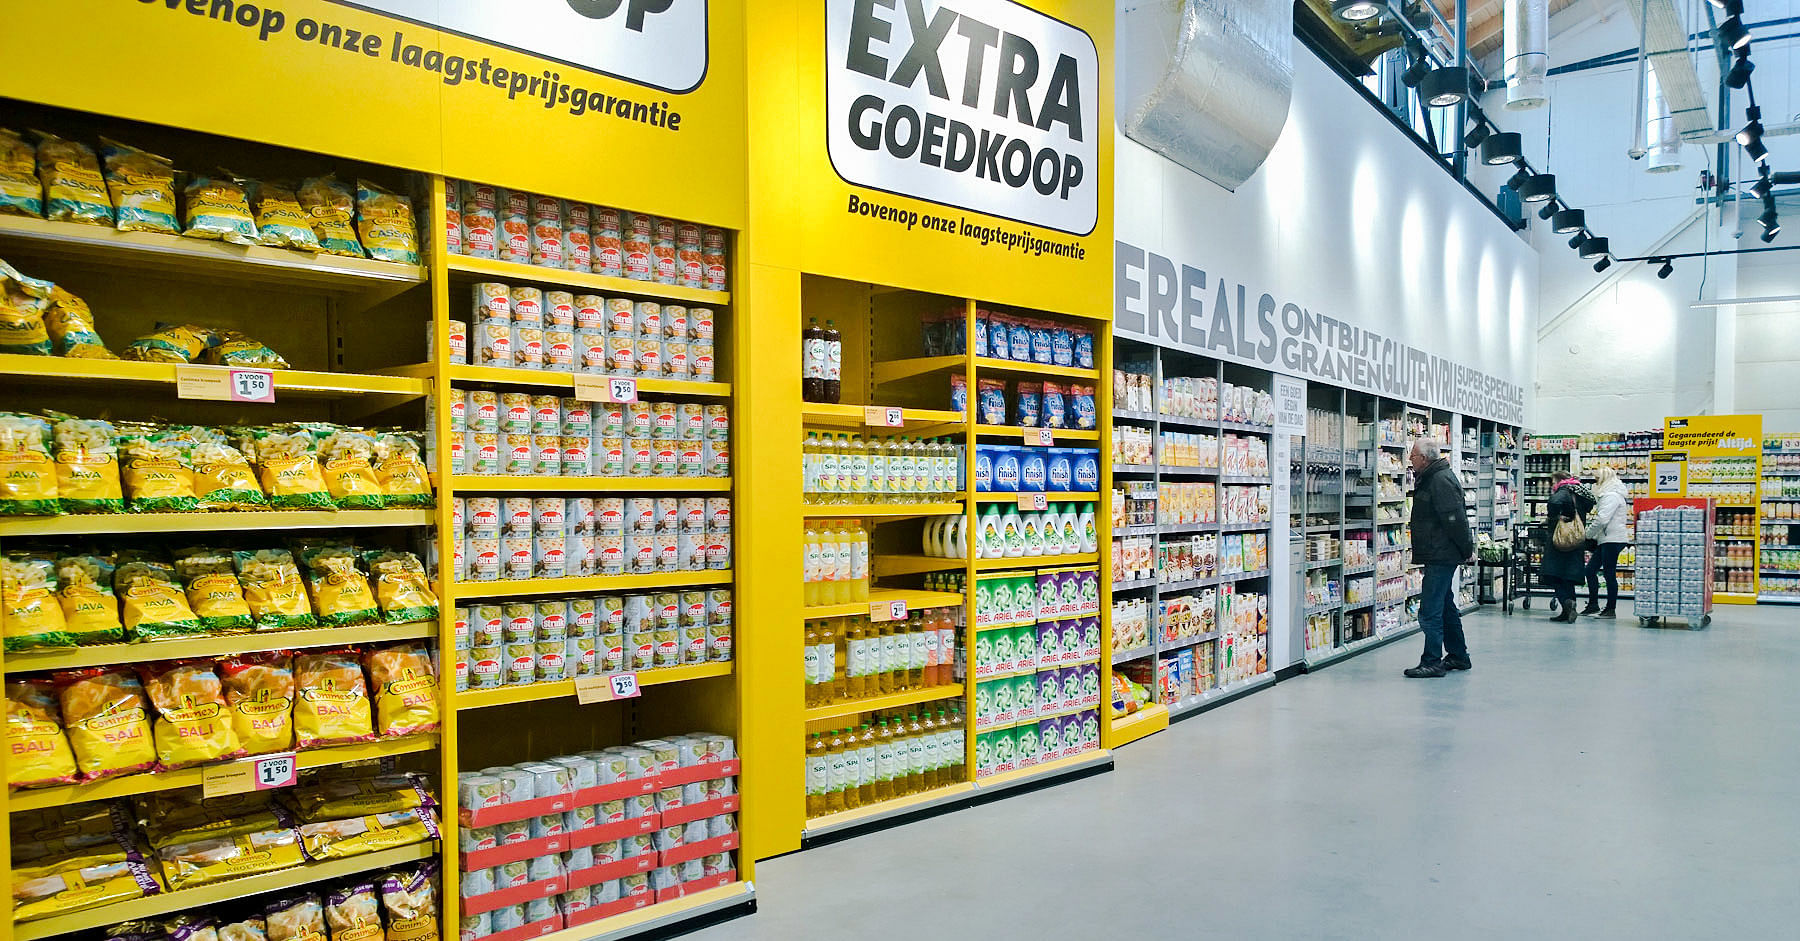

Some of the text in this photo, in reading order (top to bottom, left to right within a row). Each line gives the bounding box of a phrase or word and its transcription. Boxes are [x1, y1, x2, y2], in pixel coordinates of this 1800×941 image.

[137, 0, 682, 132] enop onze laagsteprijsgarantie
[846, 0, 1083, 143] EXTRA
[848, 94, 1084, 201] GOEDKOOP
[848, 194, 1085, 260] Bovenop onze laagsteprijsgarantie
[1115, 239, 1277, 365] EREALS
[1281, 302, 1381, 361] ONTBIJT
[1281, 336, 1381, 391] GRANEN
[1382, 338, 1457, 409] GLUTENVRIJ
[1457, 365, 1484, 392] SUPER
[1484, 374, 1524, 407] SPECIALE
[1456, 388, 1484, 415] FOODS
[1484, 396, 1523, 425] VOEDING
[1668, 431, 1724, 440] Gegarandeerd
[1668, 438, 1718, 447] laagste prijs!
[1717, 437, 1757, 451] Altijd.
[70, 470, 102, 480] JAVA
[277, 469, 306, 479] JAVA
[337, 472, 361, 482] JAVA
[976, 469, 990, 478] nish
[75, 602, 105, 612] JAVA
[144, 598, 175, 608] JAVA
[1060, 603, 1079, 613] ARIEL
[1080, 601, 1098, 610] ARIEL
[1015, 609, 1034, 619] ARIEL
[1040, 606, 1058, 614] ARIEL
[993, 611, 1013, 621] ARIEL
[1061, 651, 1081, 661] ARIEL
[1084, 648, 1101, 656] ARIEL
[1017, 659, 1036, 668] ARIEL
[1041, 654, 1060, 664] ARIEL
[995, 662, 1014, 672] ARIEL
[392, 679, 434, 693] Conimex
[402, 693, 435, 708] BALI
[1063, 698, 1082, 708] ARIEL
[1081, 694, 1099, 704] ARIEL
[1017, 707, 1036, 717] ARIEL
[1041, 702, 1060, 712] ARIEL
[995, 711, 1014, 722] ARIEL
[104, 727, 144, 743] BALI
[179, 723, 214, 739] BALI
[12, 740, 55, 755] BALI
[1082, 740, 1100, 750] ARIEL
[1041, 751, 1060, 760] ARIEL
[1062, 746, 1082, 756] ARIEL
[995, 762, 1015, 772] ARIEL
[1019, 757, 1039, 767] ARIEL
